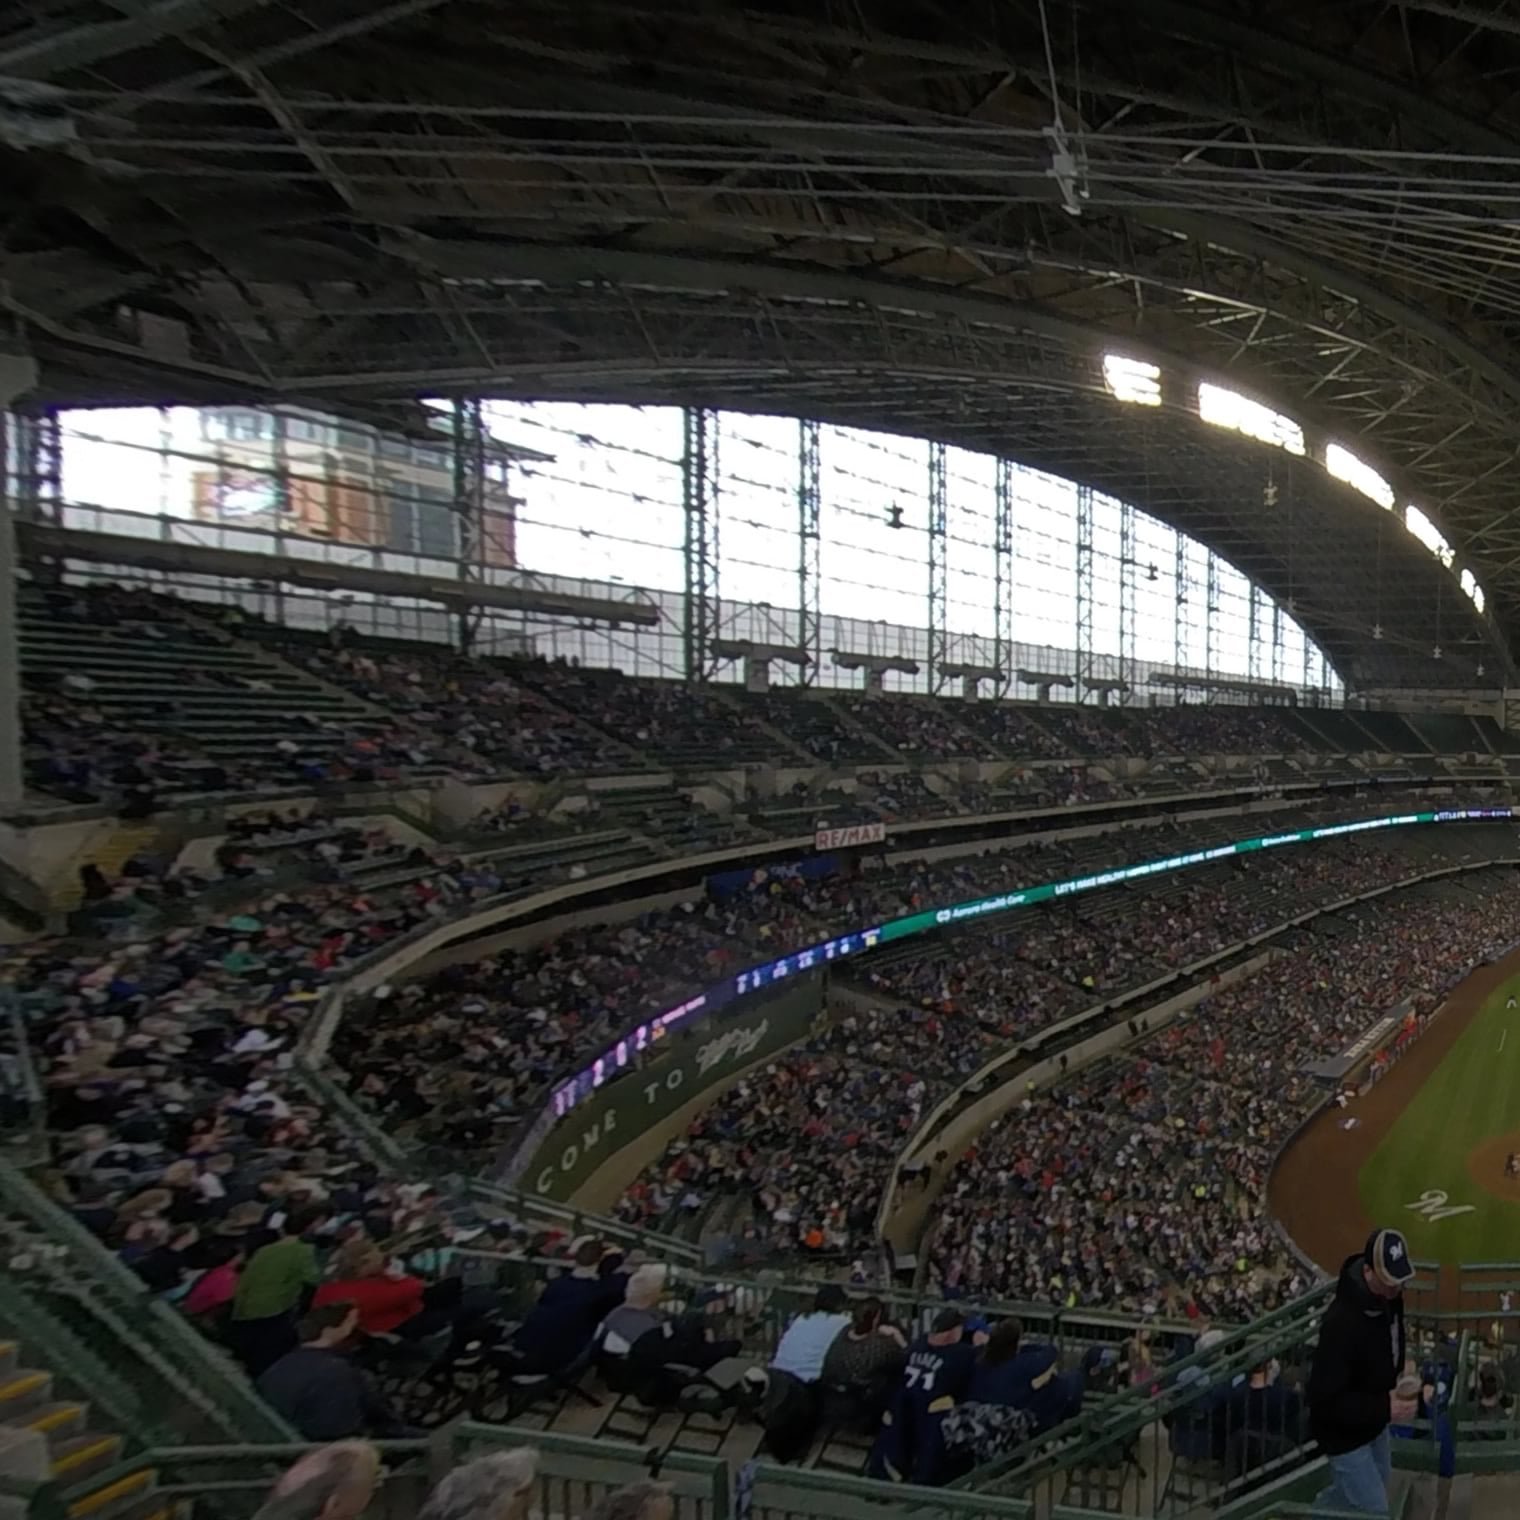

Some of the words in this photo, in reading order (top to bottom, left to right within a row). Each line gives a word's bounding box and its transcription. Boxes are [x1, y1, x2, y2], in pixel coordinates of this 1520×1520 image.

[817, 824, 882, 848] RE/MAX
[536, 1109, 617, 1194] COME
[643, 1069, 684, 1104] TO
[904, 1364, 936, 1392] 71
